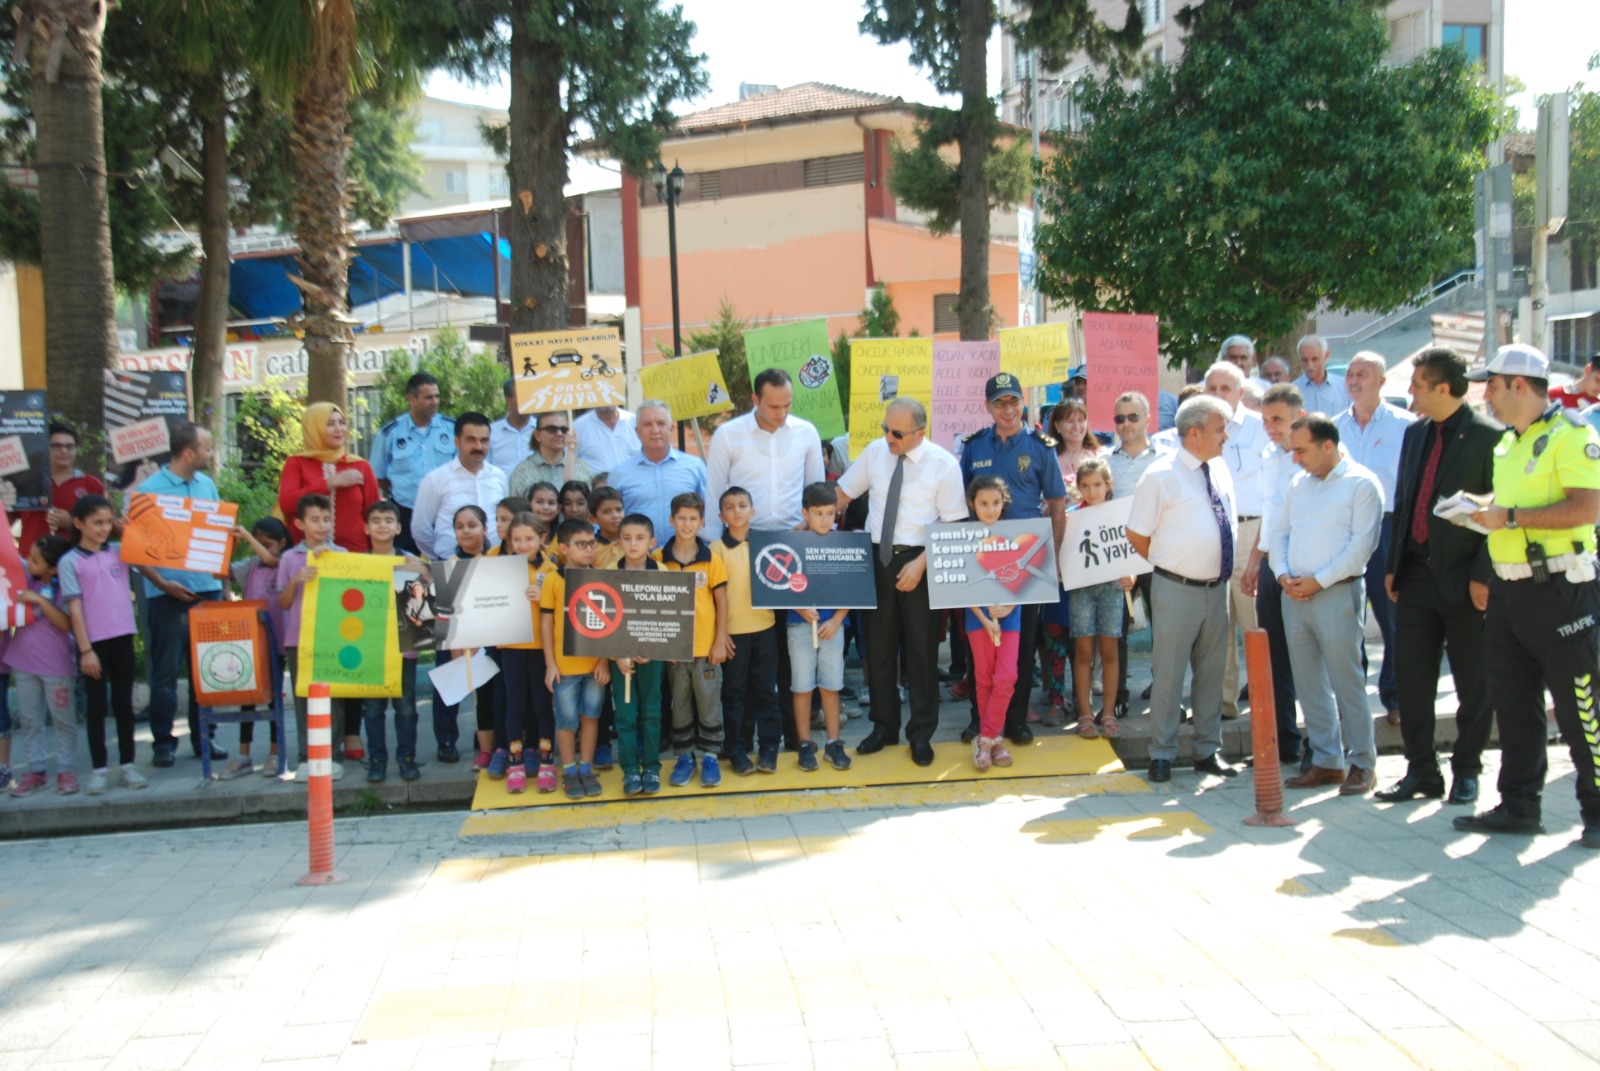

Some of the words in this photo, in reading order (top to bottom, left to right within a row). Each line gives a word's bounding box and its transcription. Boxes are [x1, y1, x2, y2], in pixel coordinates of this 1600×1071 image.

[931, 528, 990, 544] emniyet
[1099, 525, 1127, 544] önc
[931, 539, 1019, 556] kemerinizle
[933, 557, 966, 569] dost
[934, 571, 967, 584] olun
[621, 584, 661, 593] TELEFONU
[663, 585, 689, 594] BIRAK,
[634, 593, 656, 601] YOLA
[657, 593, 676, 602] BAK!
[55, 688, 69, 708] S
